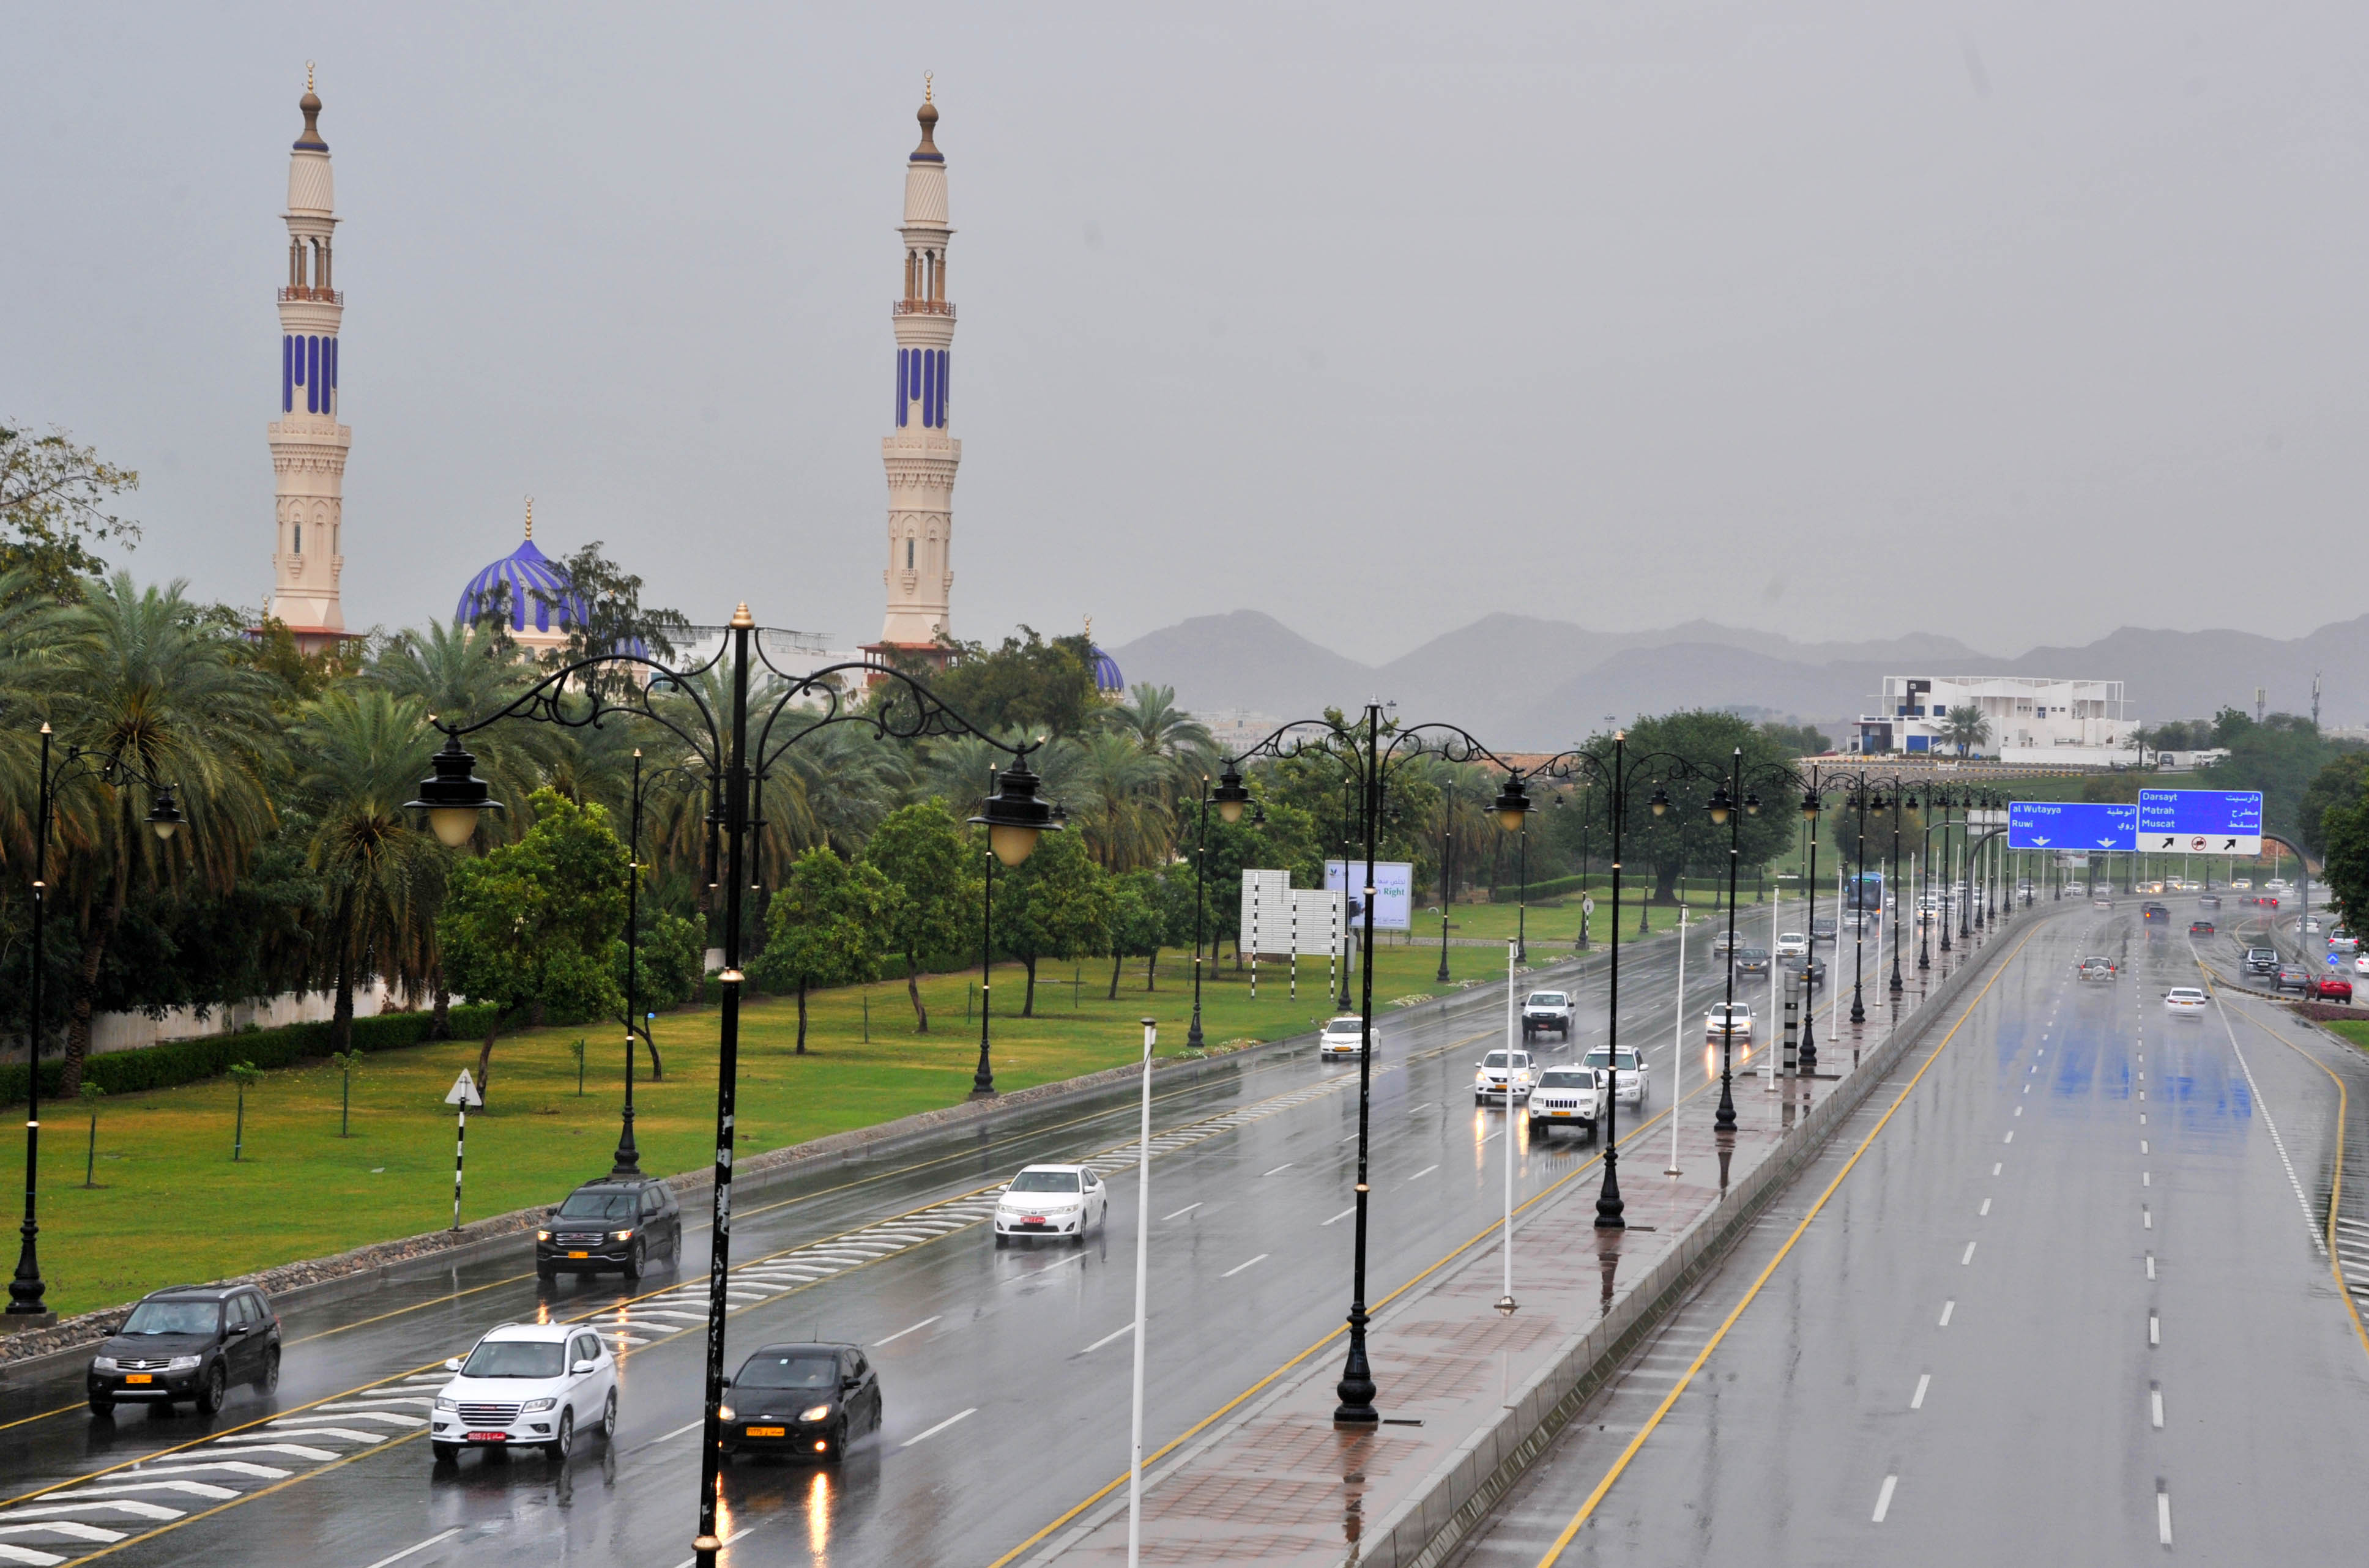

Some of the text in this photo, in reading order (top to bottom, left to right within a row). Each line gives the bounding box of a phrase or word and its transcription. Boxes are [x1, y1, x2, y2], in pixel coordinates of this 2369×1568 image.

[2143, 793, 2177, 802] Darsayt
[2023, 805, 2061, 815] Wutayya
[2107, 808, 2135, 817] الوطية
[2232, 808, 2258, 817] مطرح
[1384, 887, 1404, 897] Right
